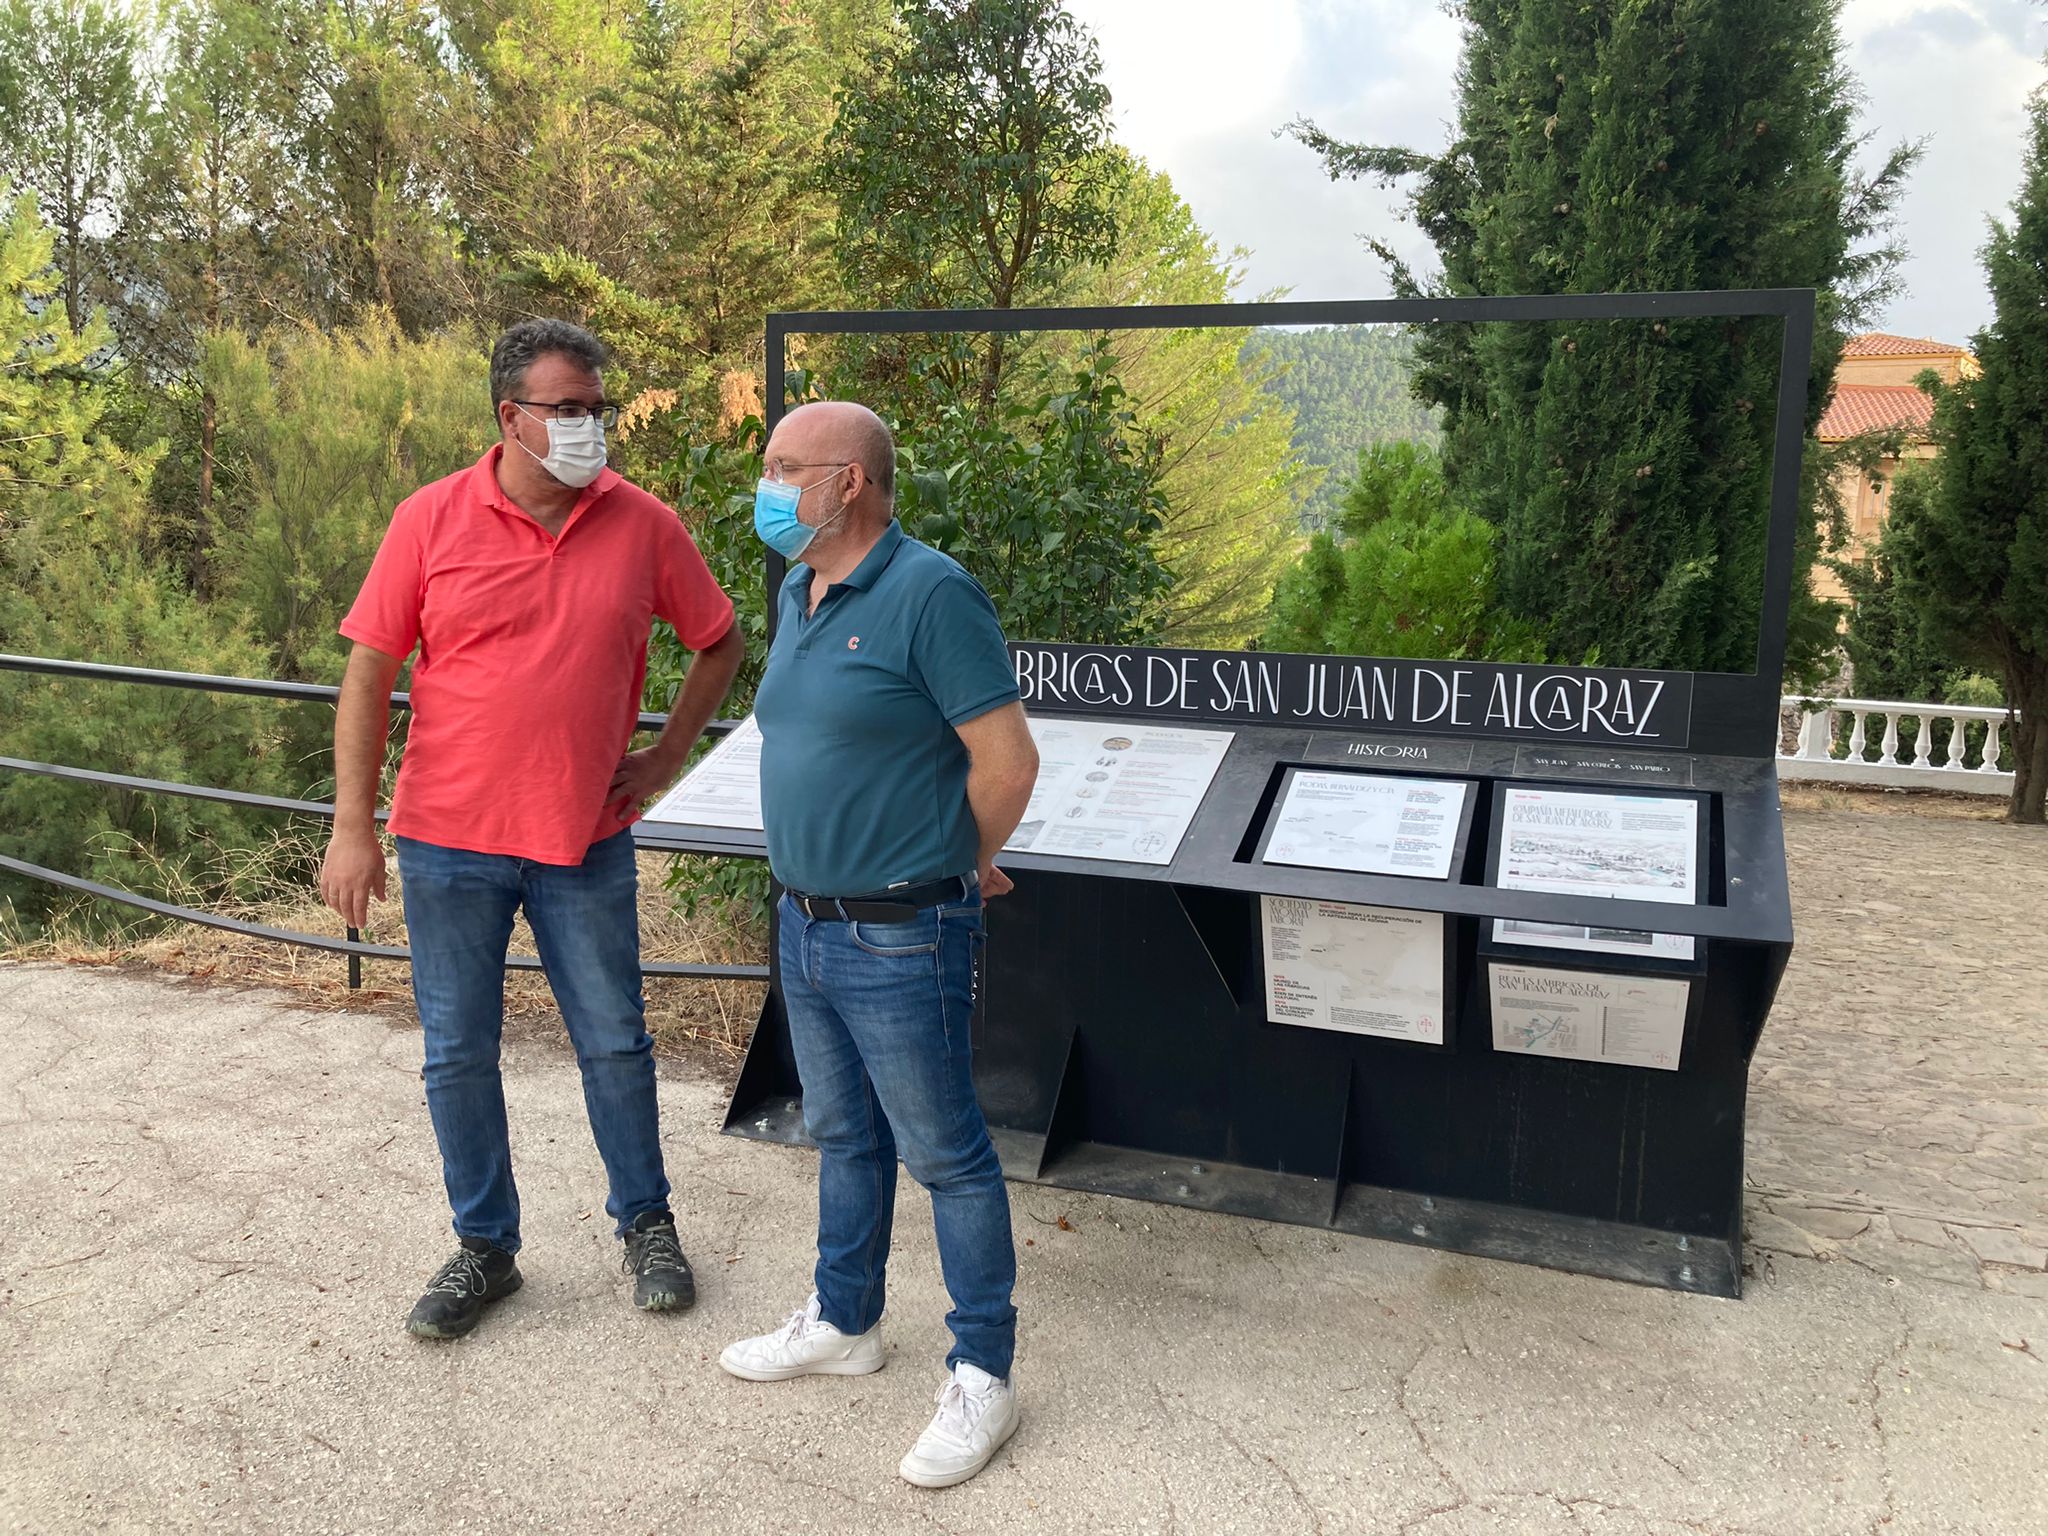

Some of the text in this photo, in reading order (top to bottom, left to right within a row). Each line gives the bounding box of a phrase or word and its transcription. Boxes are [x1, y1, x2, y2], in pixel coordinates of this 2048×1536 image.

[1146, 656, 1199, 709] DE
[1210, 659, 1280, 714] SAN
[1293, 663, 1397, 722] JUAN
[1412, 669, 1473, 726] DE
[1484, 673, 1665, 738] ALCARAZ
[1347, 744, 1429, 760] HISTORIA
